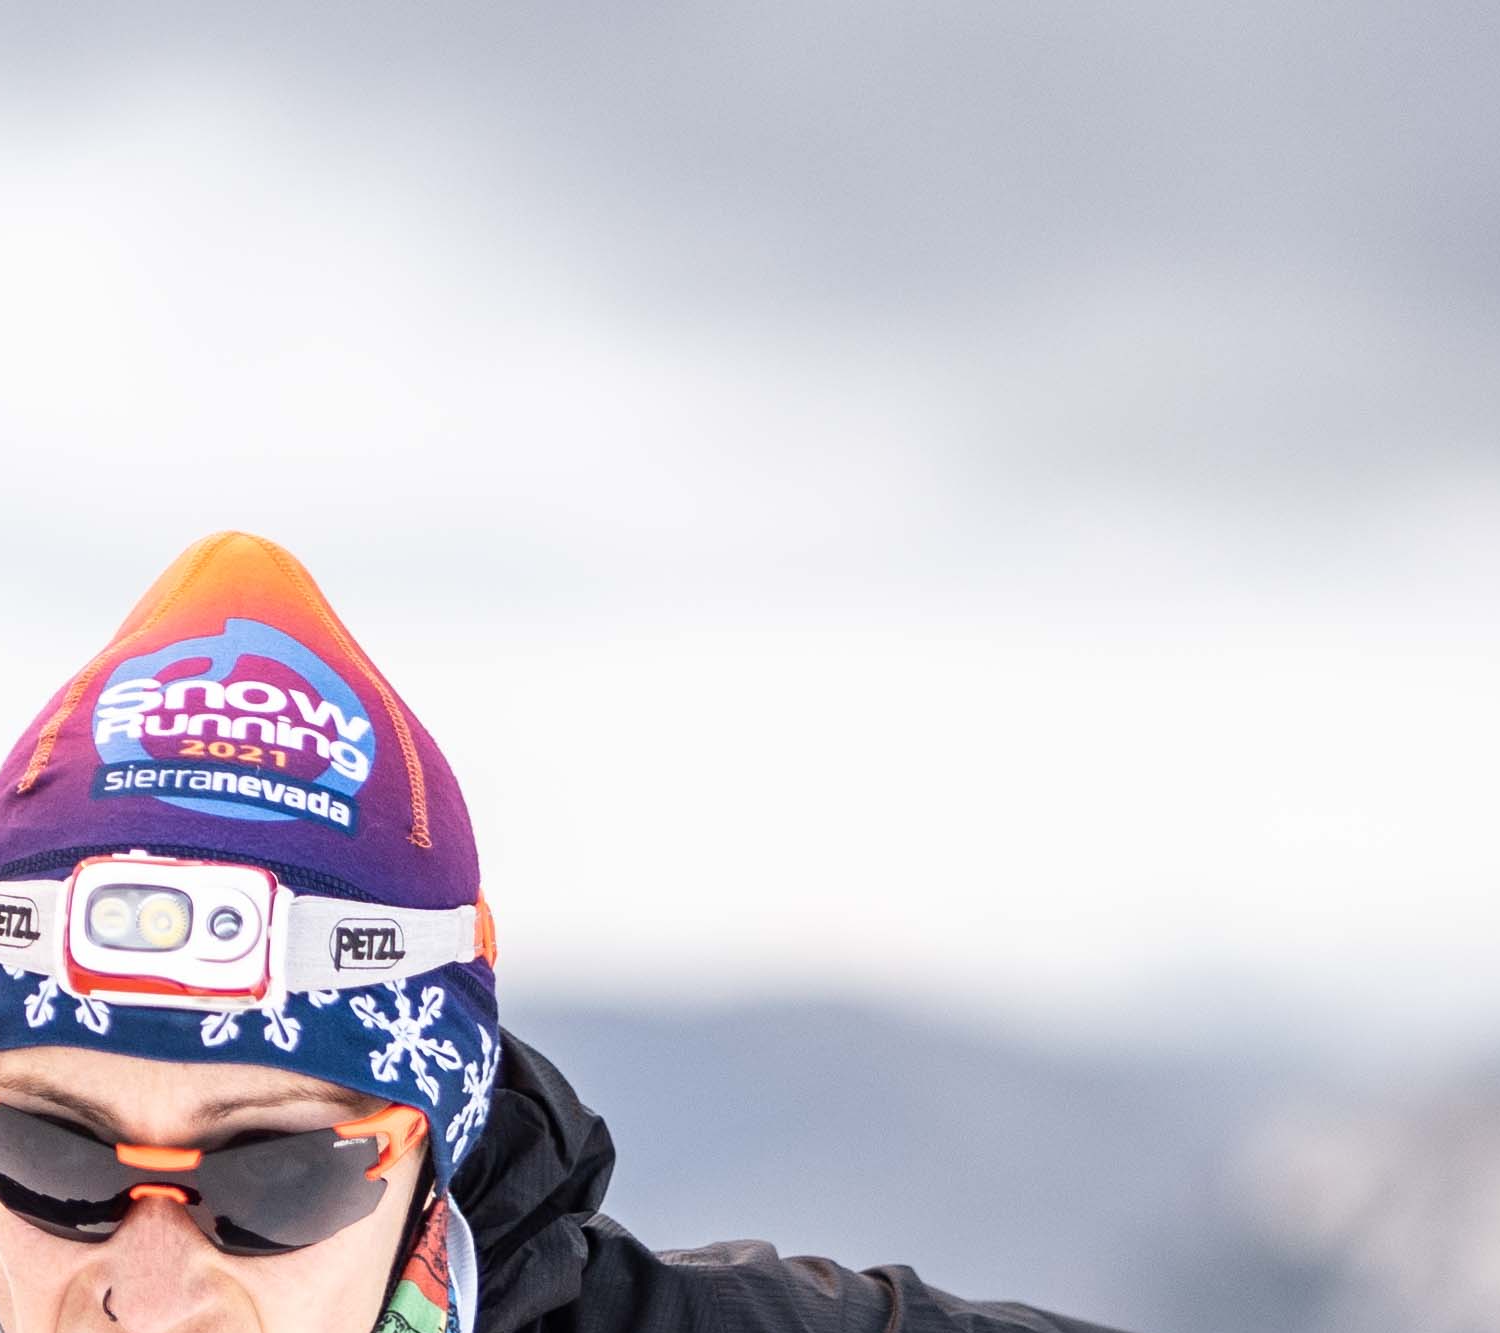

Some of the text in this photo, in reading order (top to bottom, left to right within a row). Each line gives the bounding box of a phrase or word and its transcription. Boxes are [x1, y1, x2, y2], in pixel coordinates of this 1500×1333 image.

[94, 712, 369, 783] Running
[179, 739, 287, 768] 2021
[334, 925, 406, 972] PETZL
